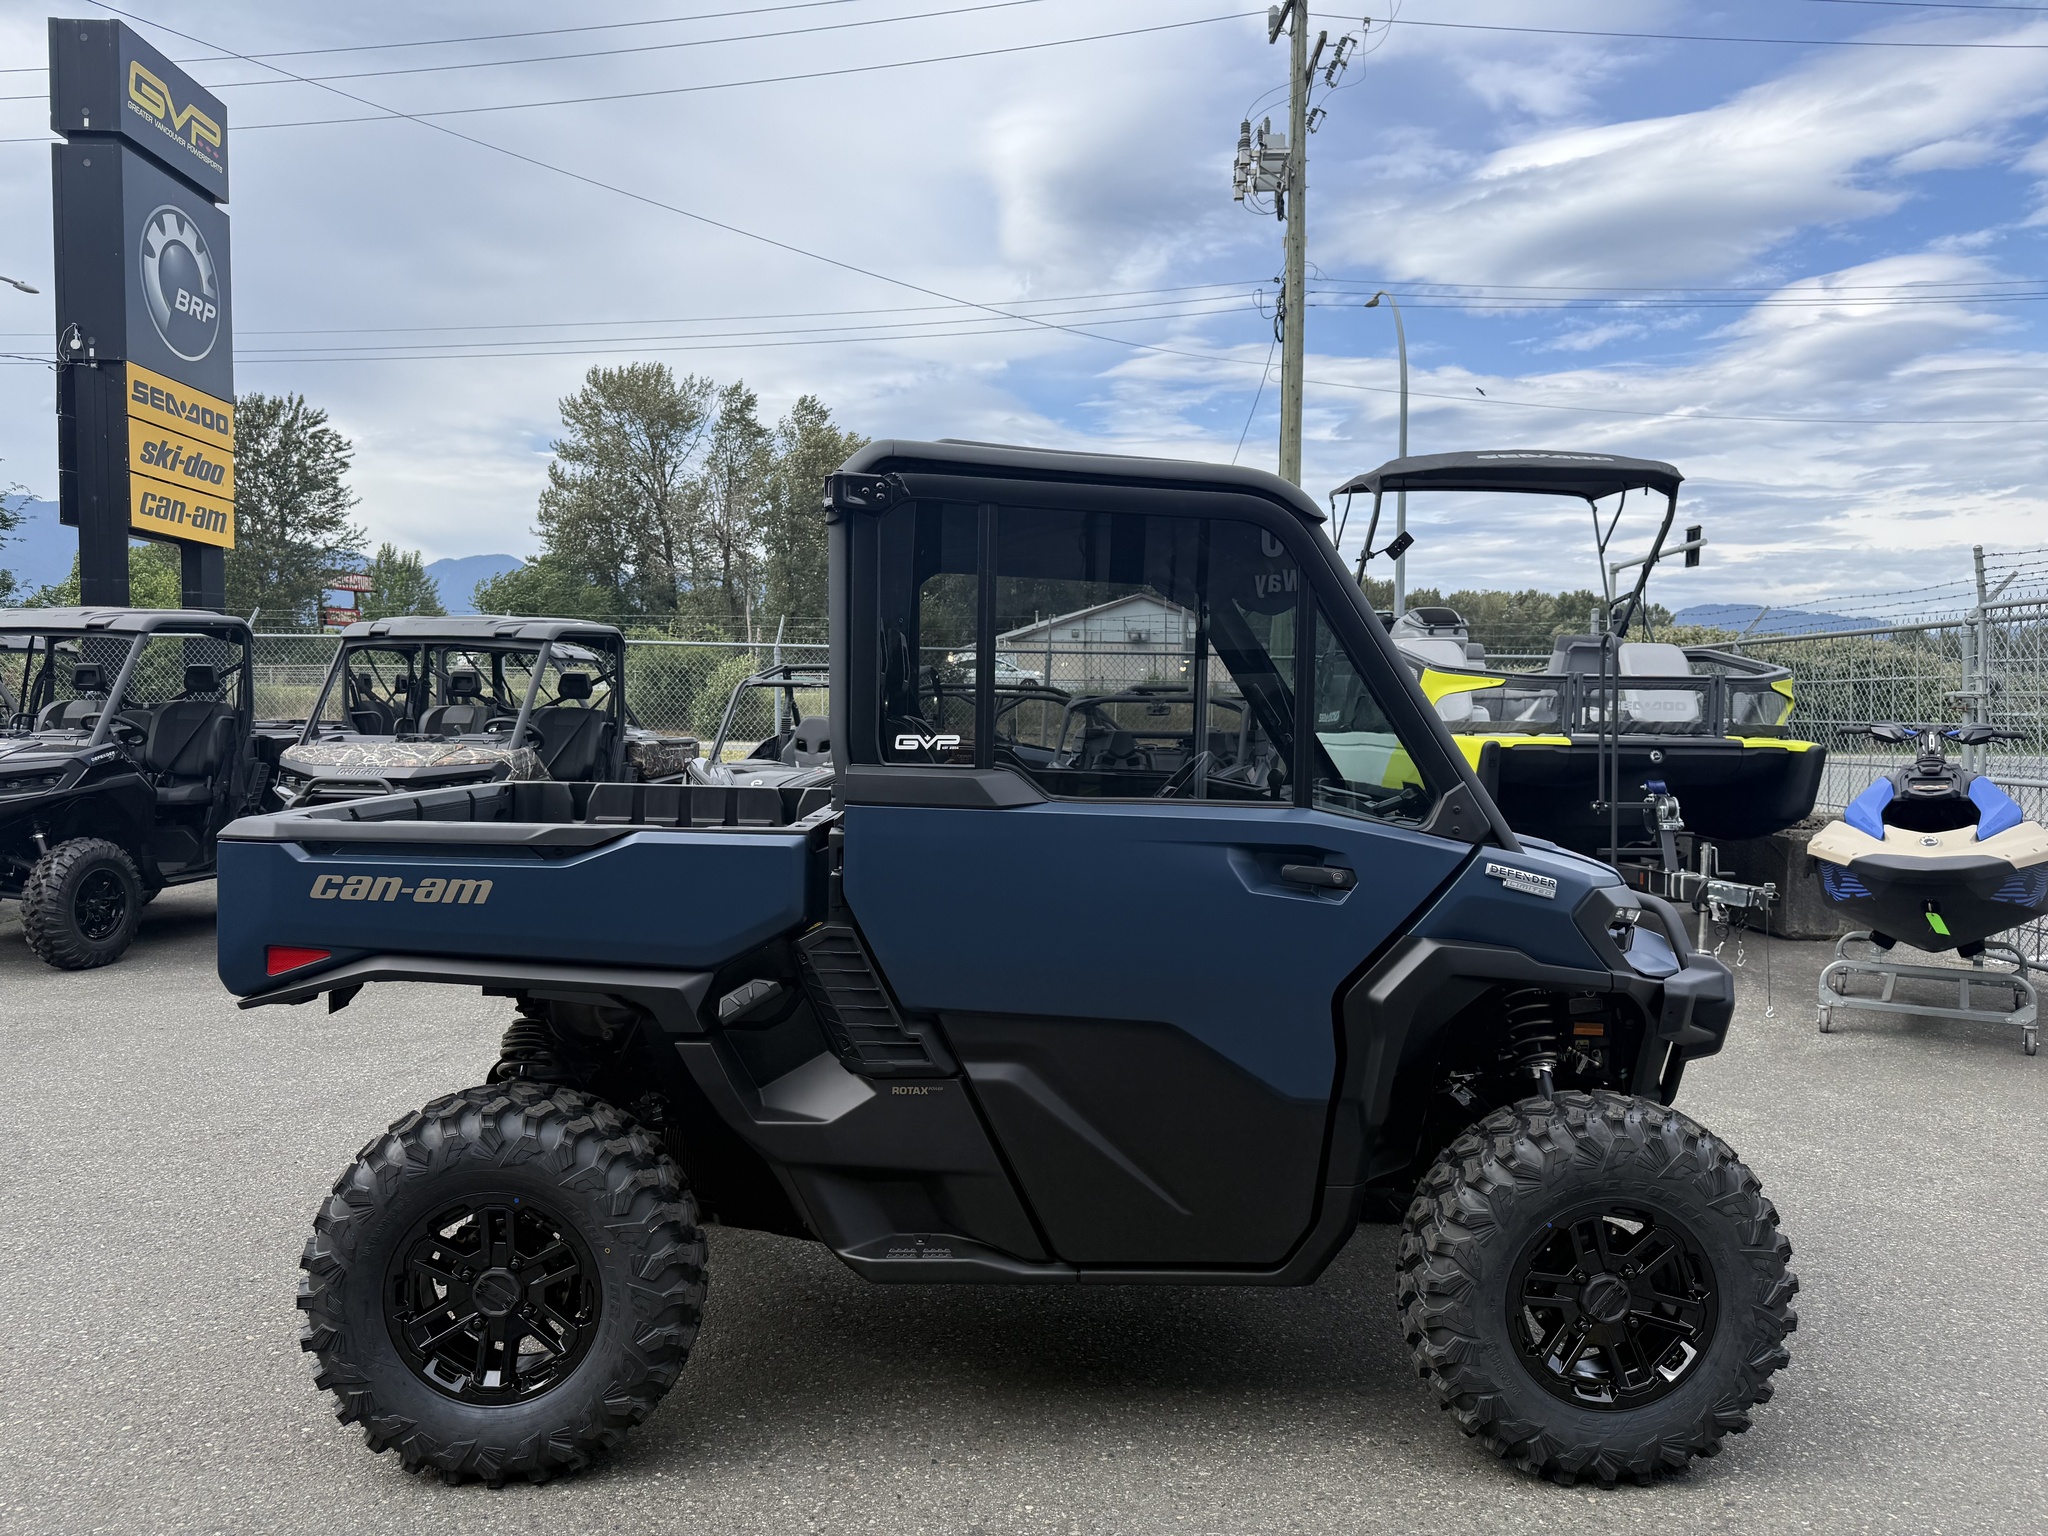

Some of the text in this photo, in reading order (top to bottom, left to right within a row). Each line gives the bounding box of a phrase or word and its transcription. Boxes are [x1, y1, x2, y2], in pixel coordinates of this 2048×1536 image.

[129, 60, 221, 148] GVP
[127, 100, 223, 174] GREATER VANCOUVER POWERSPORTS
[175, 287, 216, 323] BRP
[140, 440, 225, 485] ski-doo
[140, 491, 227, 534] can-am
[895, 734, 960, 751] GVP
[309, 874, 494, 905] can-am
[1490, 865, 1556, 888] DEFENDER
[892, 1086, 928, 1095] ROTAX
